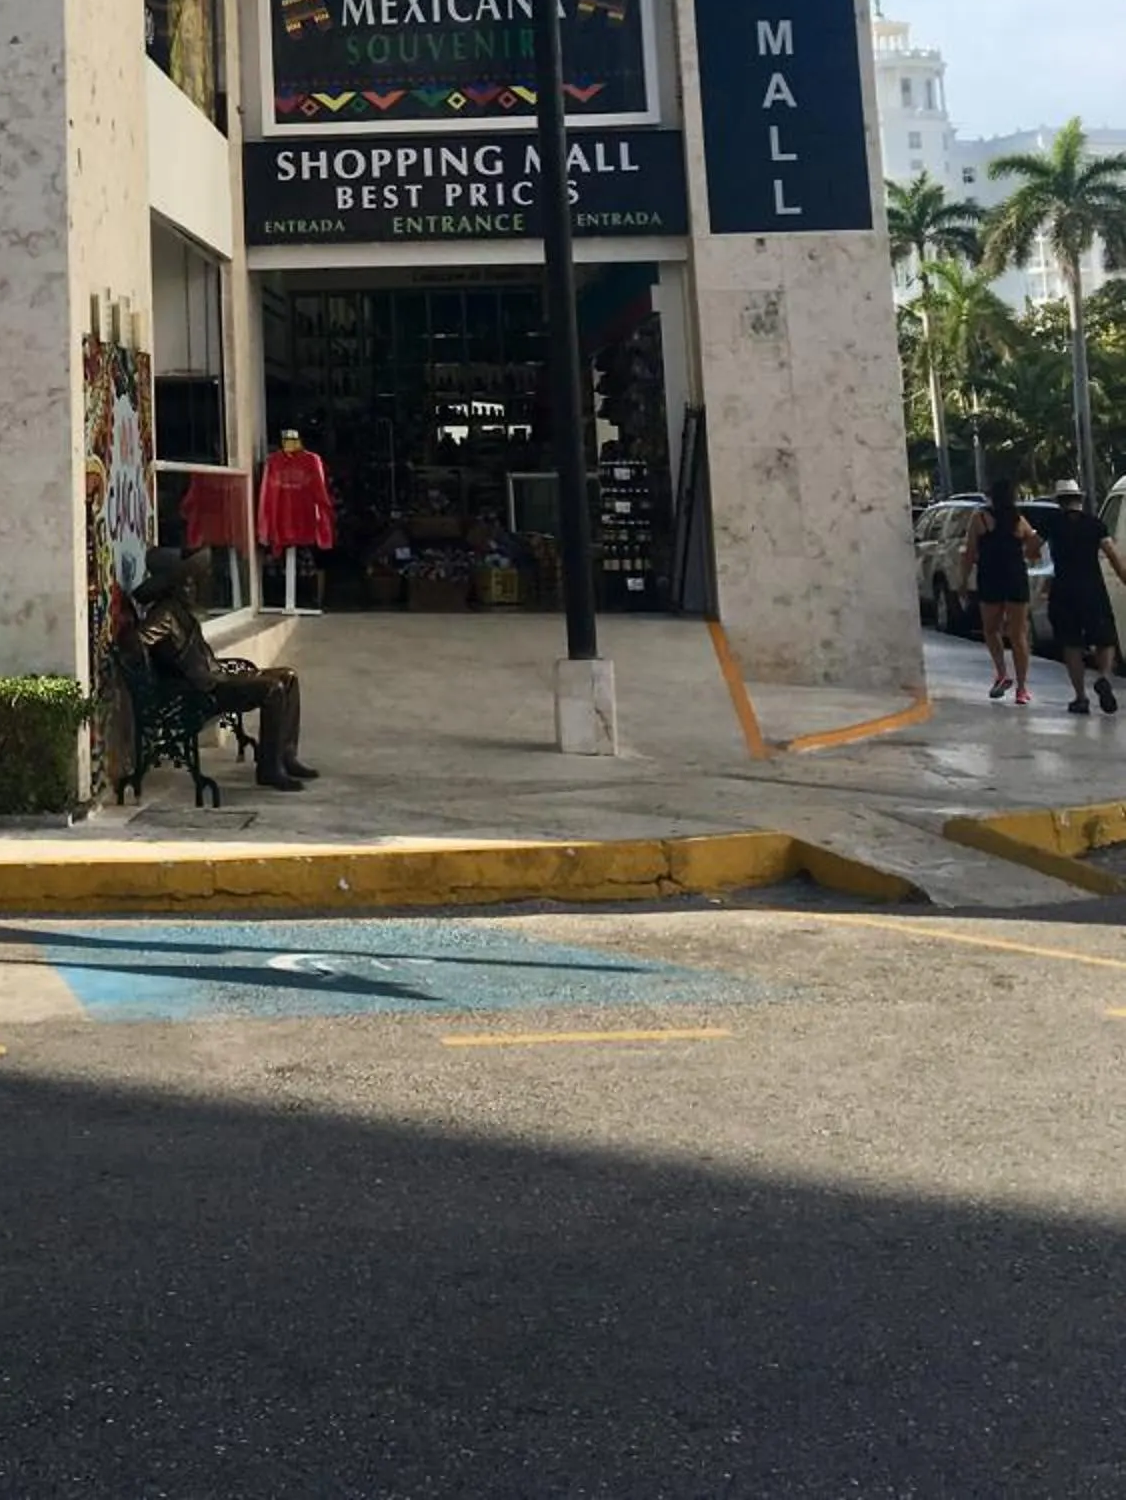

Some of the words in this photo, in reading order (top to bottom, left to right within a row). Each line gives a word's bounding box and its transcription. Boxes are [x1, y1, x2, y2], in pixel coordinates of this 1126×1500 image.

[756, 20, 802, 215] MALL
[276, 146, 505, 181] SHOPPING
[336, 184, 423, 210] BEST
[444, 179, 580, 208] PRICS
[265, 219, 346, 234] ENTRADA
[393, 213, 525, 234] ENTRANCE
[576, 211, 663, 227] ENTRADA
